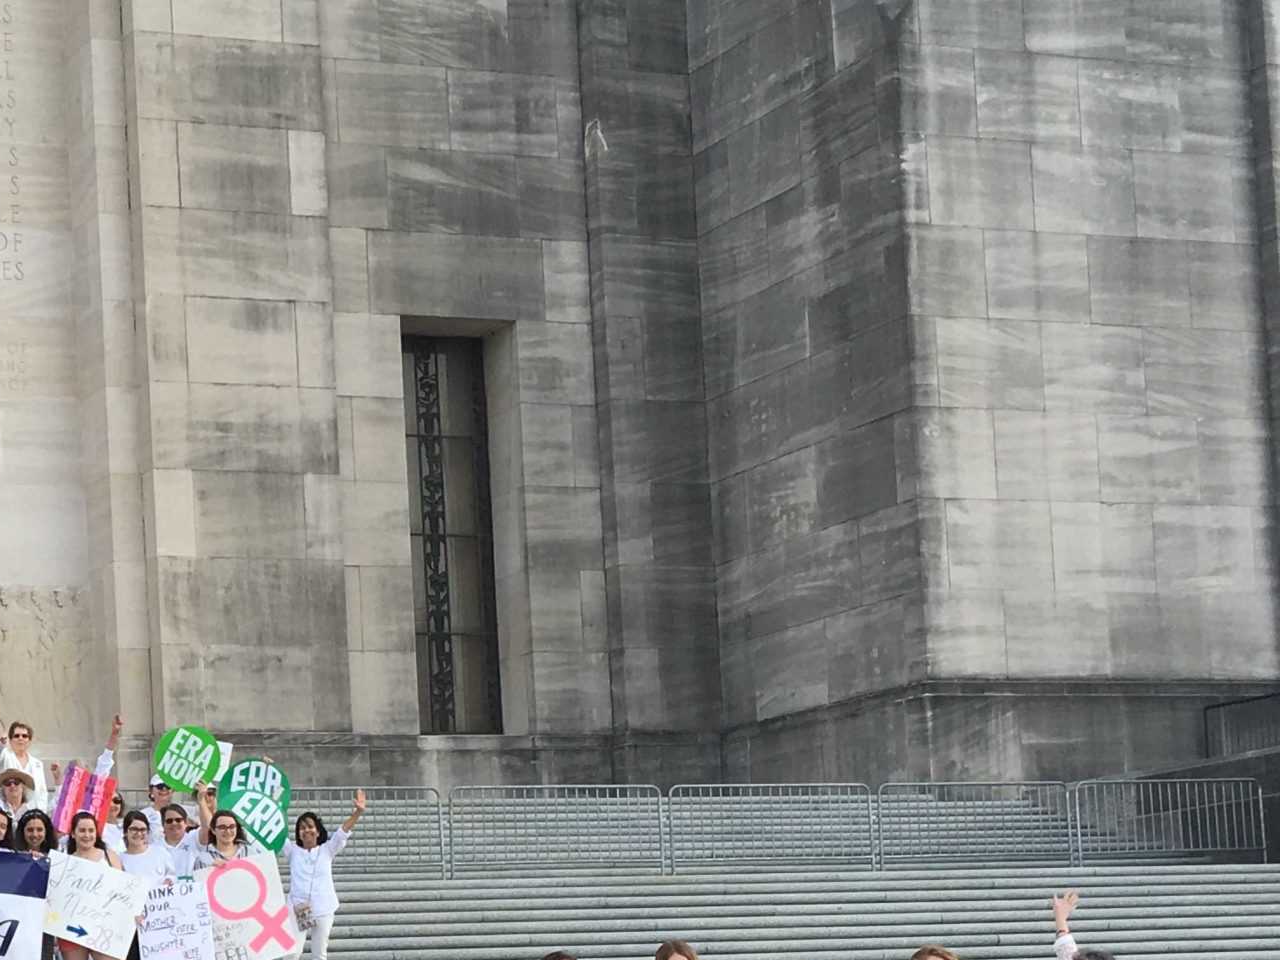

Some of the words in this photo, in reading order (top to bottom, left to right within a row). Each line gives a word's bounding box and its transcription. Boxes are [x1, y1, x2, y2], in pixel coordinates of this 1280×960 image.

[168, 727, 215, 770] ERA
[157, 750, 206, 790] NOW
[230, 761, 281, 797] ERA
[232, 791, 285, 844] ERA
